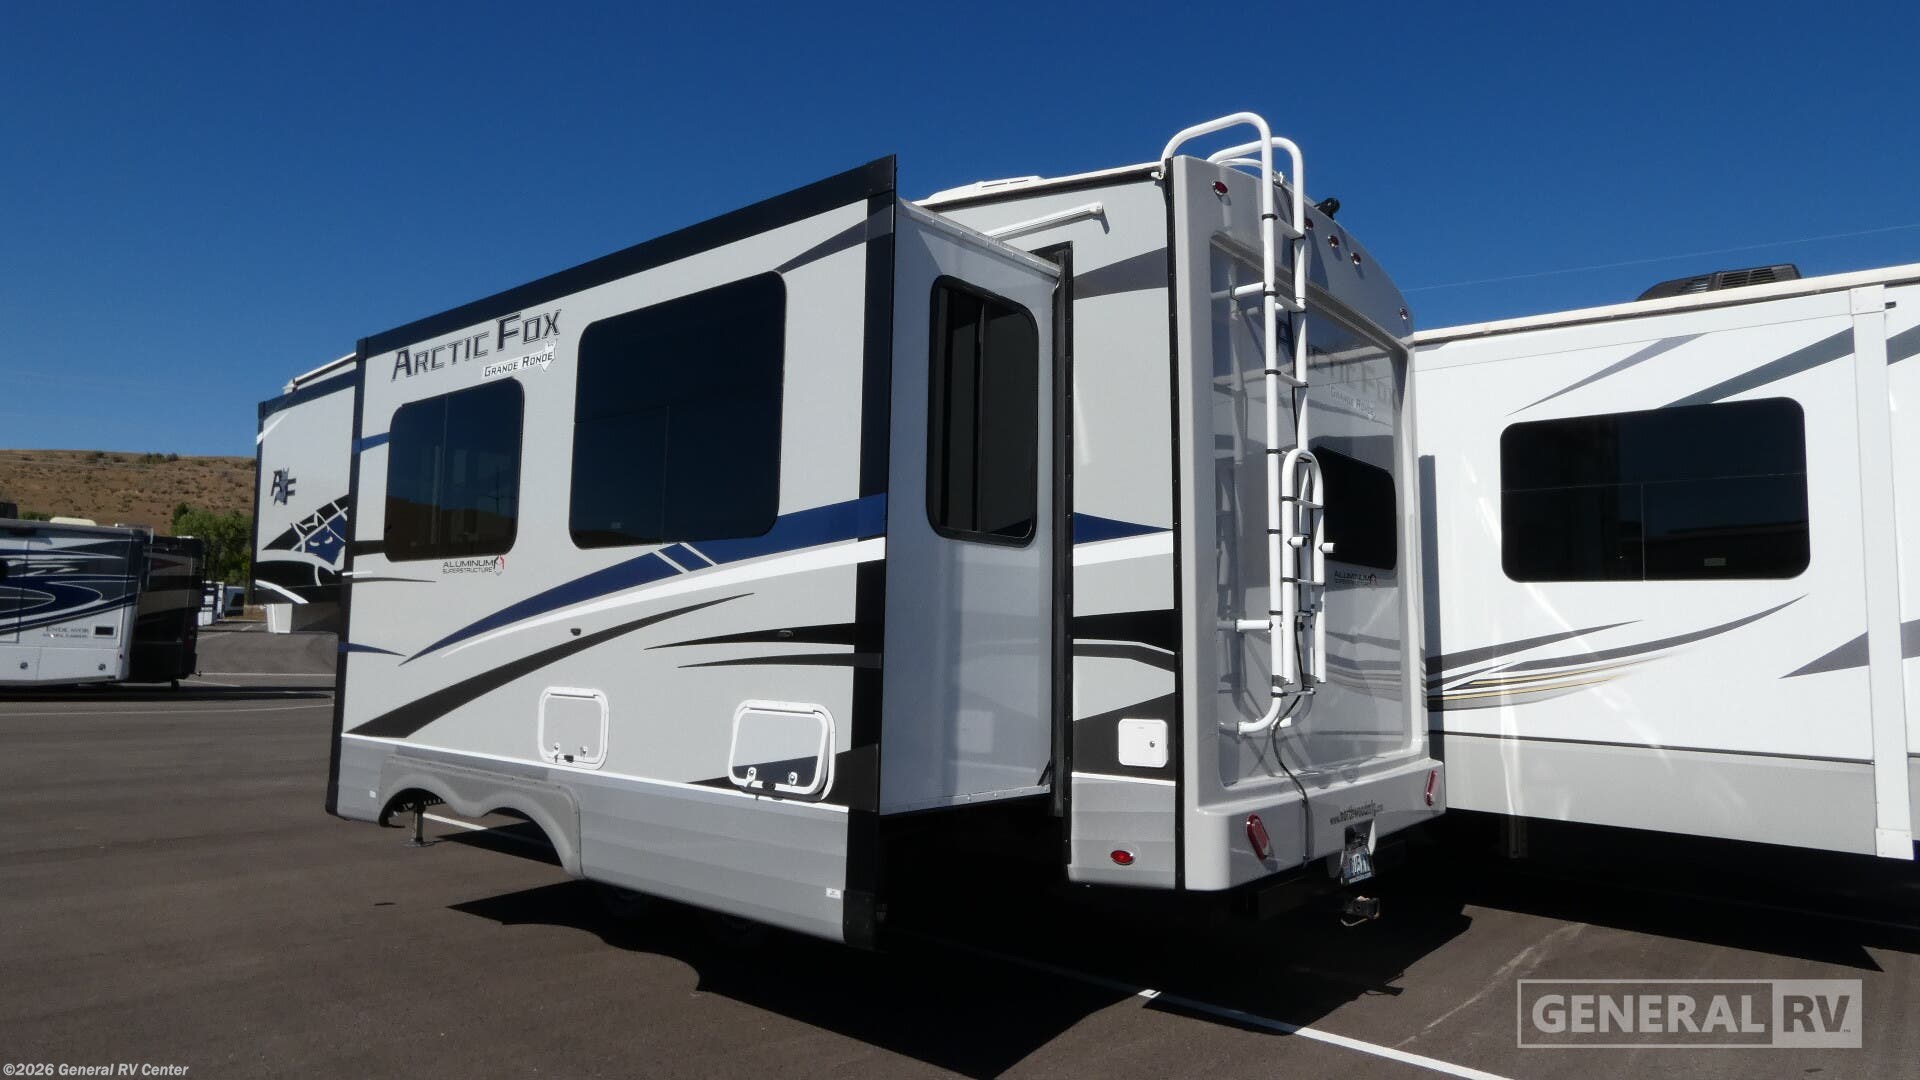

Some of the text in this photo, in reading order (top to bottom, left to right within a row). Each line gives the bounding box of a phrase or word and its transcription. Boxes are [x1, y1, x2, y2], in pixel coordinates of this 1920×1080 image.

[391, 309, 562, 382] ARCTIC FOX
[484, 351, 555, 377] GRANDE RONDE
[443, 560, 494, 568] ALUMINUM
